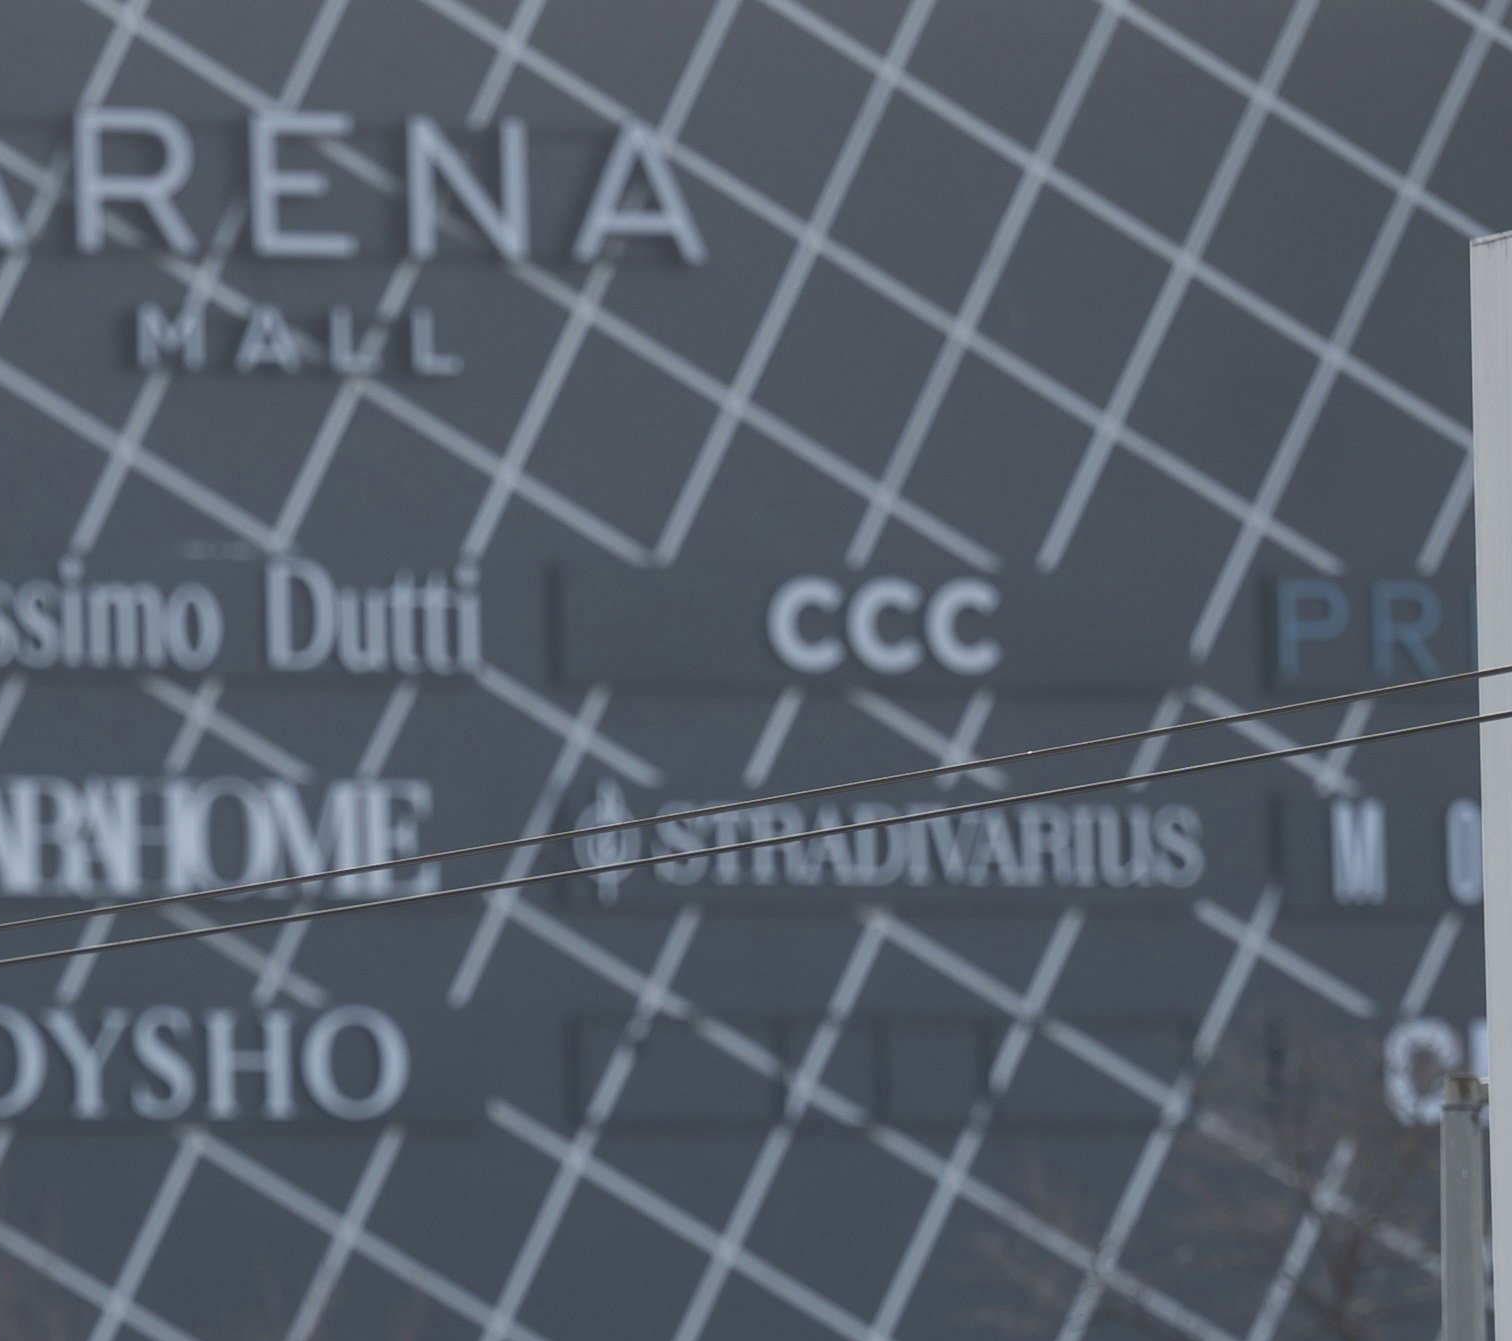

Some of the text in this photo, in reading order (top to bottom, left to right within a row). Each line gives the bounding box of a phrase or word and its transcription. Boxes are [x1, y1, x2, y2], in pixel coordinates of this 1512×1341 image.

[134, 302, 464, 376] MALL
[264, 554, 484, 673] Dutti
[768, 575, 1003, 675] CCC
[1276, 580, 1479, 676] PR
[651, 802, 1204, 890] STRADIVARIUS
